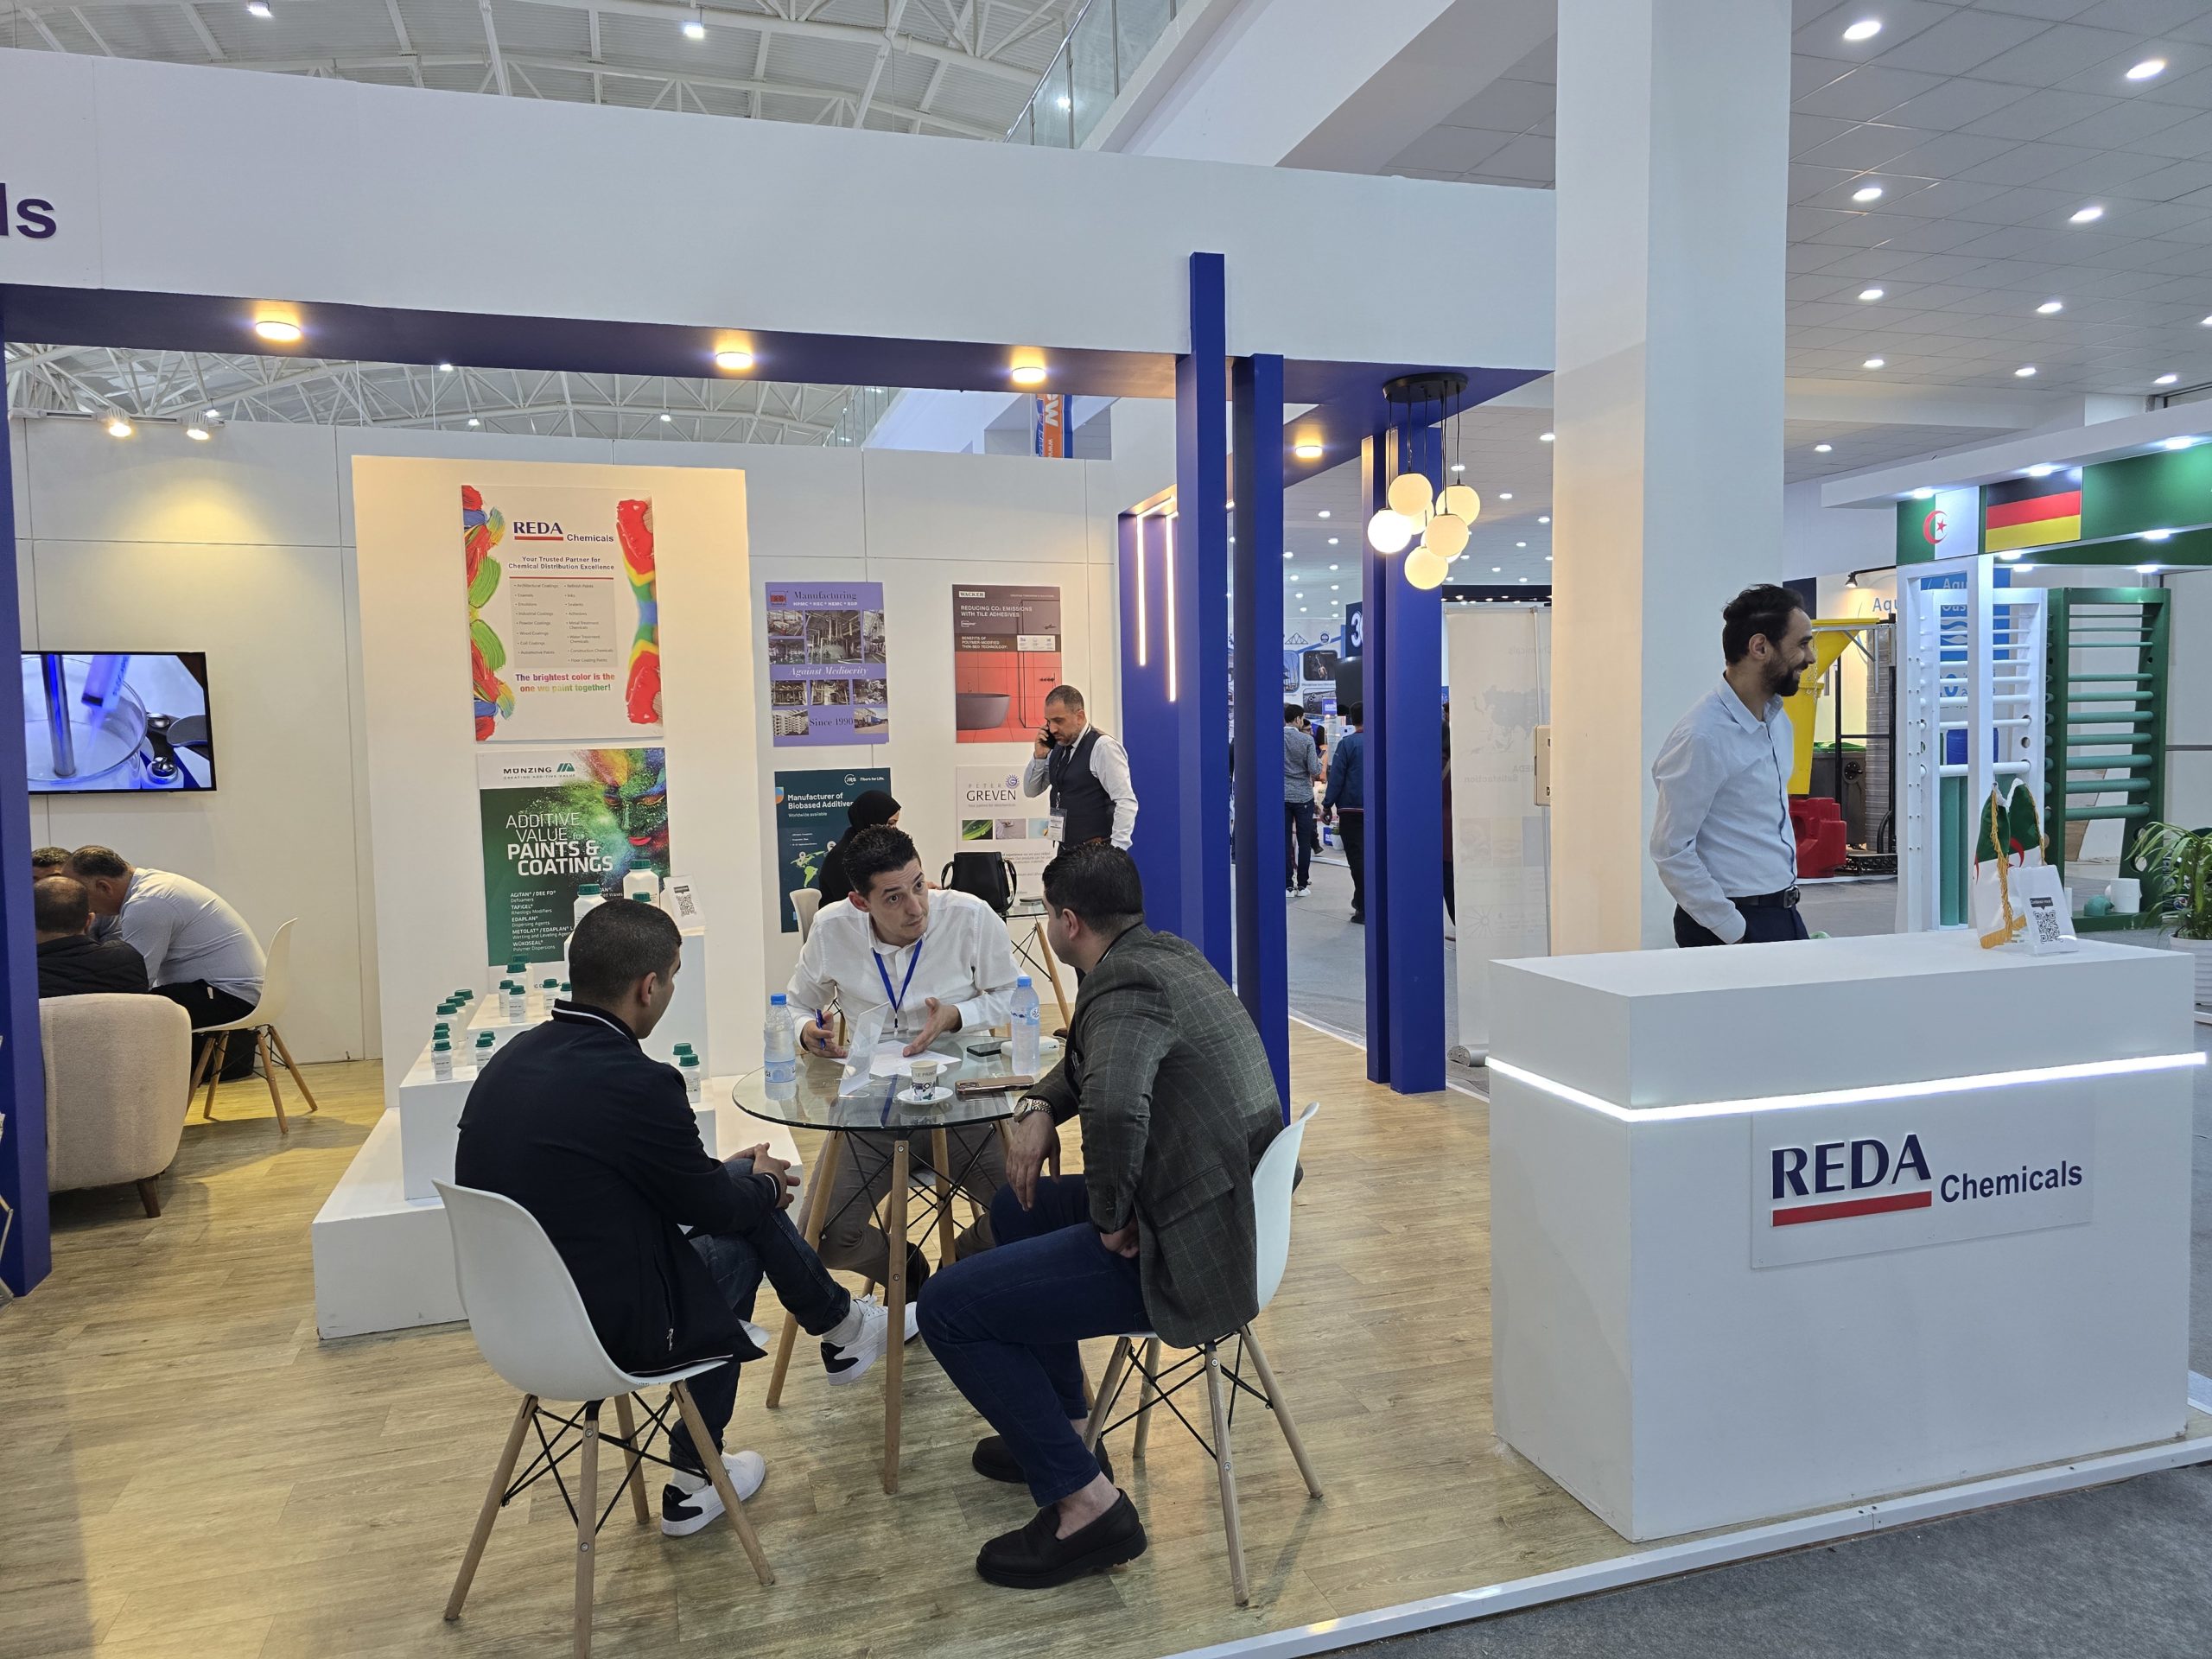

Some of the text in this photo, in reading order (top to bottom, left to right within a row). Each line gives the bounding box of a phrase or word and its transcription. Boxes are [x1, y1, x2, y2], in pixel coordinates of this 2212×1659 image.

[513, 522, 563, 534] REDA
[794, 591, 857, 600] Manufacturing
[1351, 611, 1363, 647] 3
[790, 666, 868, 677] Against Mediocrity
[552, 684, 572, 693] paint
[575, 683, 611, 692] together!
[810, 717, 854, 727] Since 1990
[967, 790, 1016, 801] GREVEN
[505, 812, 581, 829] ADDITIVE
[516, 828, 568, 842] VALUE
[507, 840, 600, 860] PAINTS &
[518, 856, 613, 876] COATINGS
[1771, 1133, 2082, 1203] REDA Chemicals
